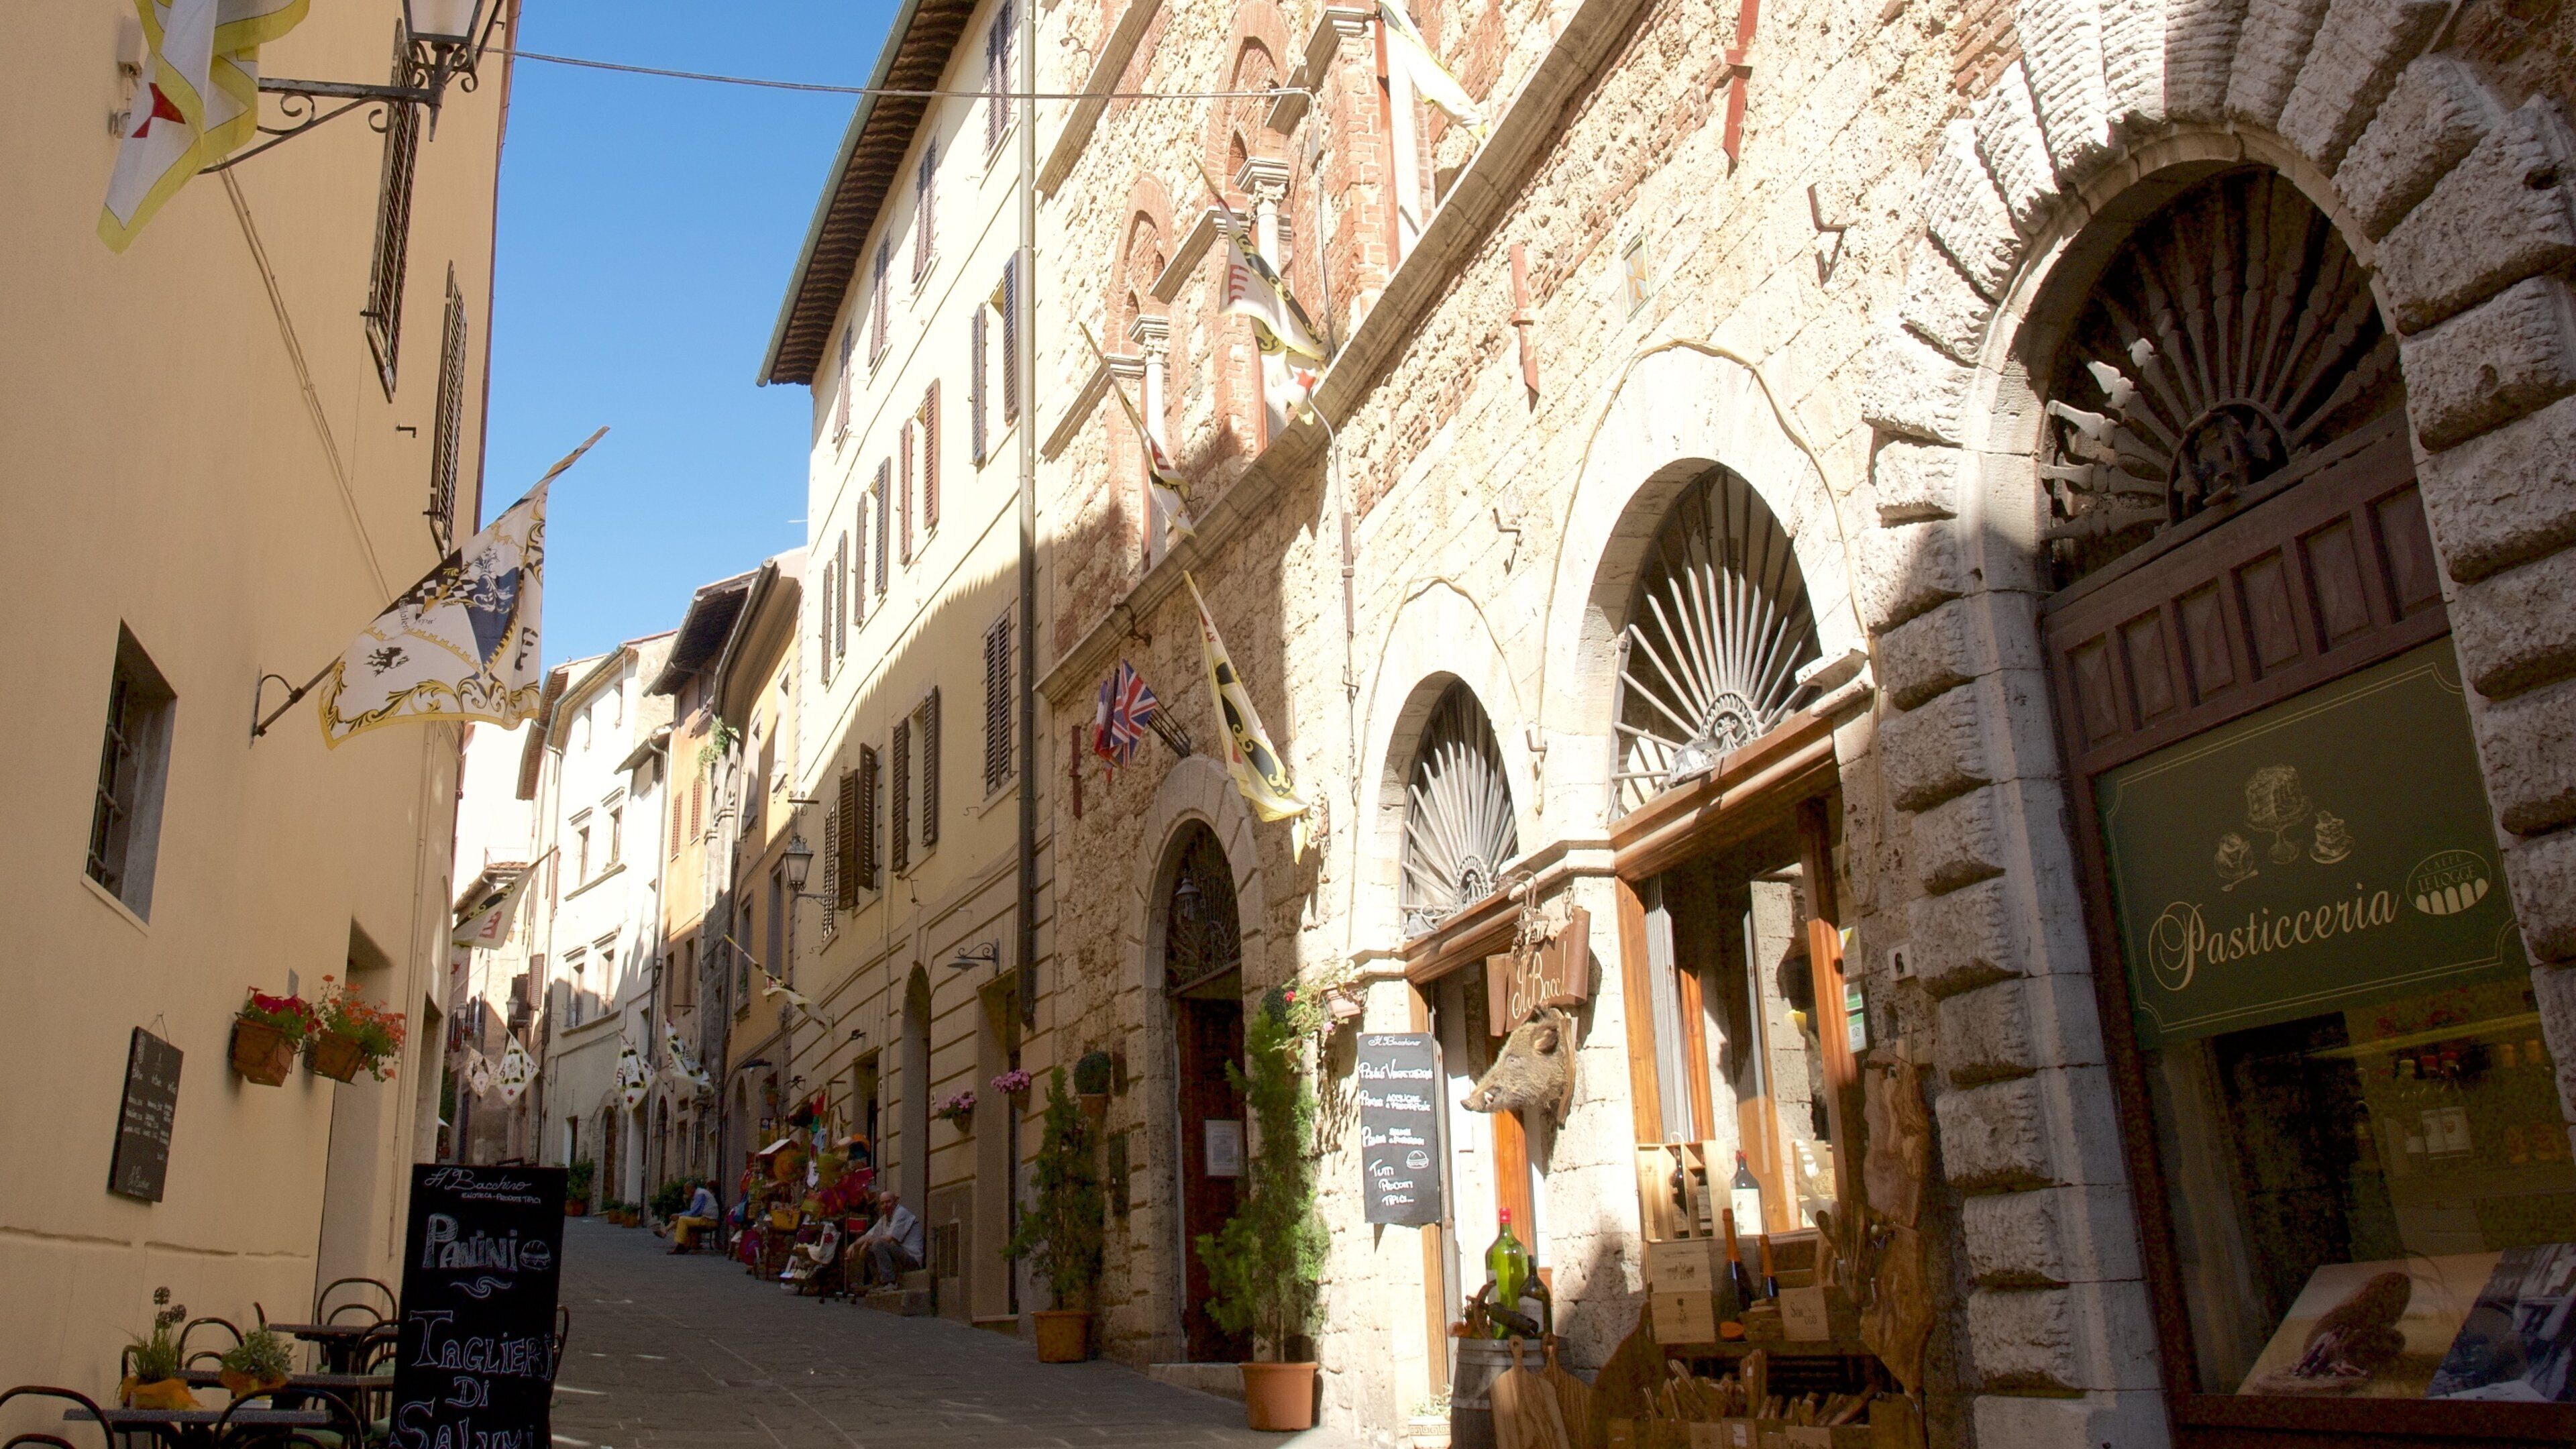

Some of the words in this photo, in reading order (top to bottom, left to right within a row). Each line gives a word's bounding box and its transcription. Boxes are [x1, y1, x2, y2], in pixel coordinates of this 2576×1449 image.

[2434, 865, 2476, 888] LOGGE
[2148, 882, 2400, 991] Pasticceria
[445, 1169, 532, 1191] Bacchino
[462, 1191, 492, 1199] ENOTECA
